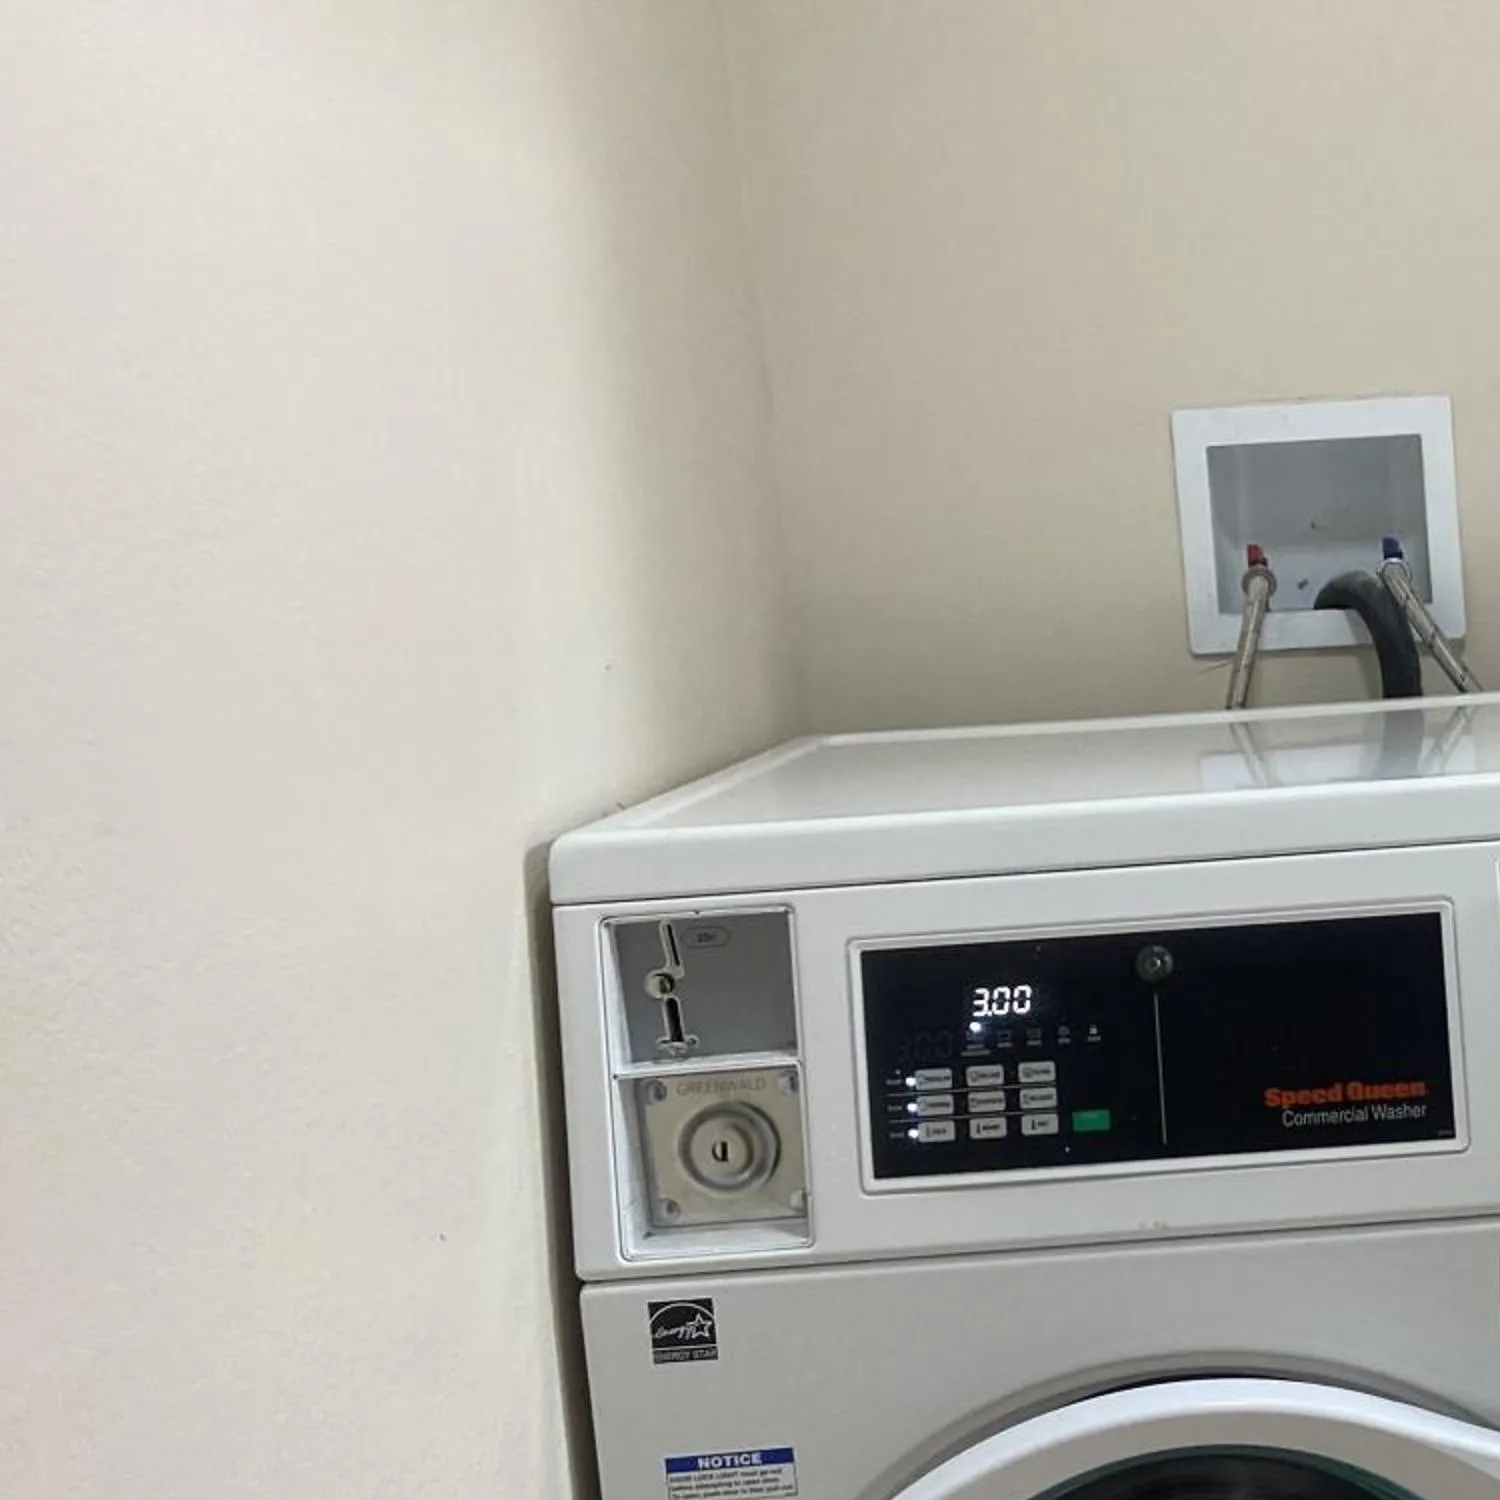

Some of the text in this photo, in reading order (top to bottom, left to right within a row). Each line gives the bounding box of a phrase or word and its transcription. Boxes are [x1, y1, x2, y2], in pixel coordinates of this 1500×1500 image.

[972, 984, 1032, 1017] 3.00
[1264, 1080, 1427, 1109] Speed Queen
[1281, 1104, 1427, 1128] Commercial Washer
[697, 1452, 763, 1469] NOTICE
